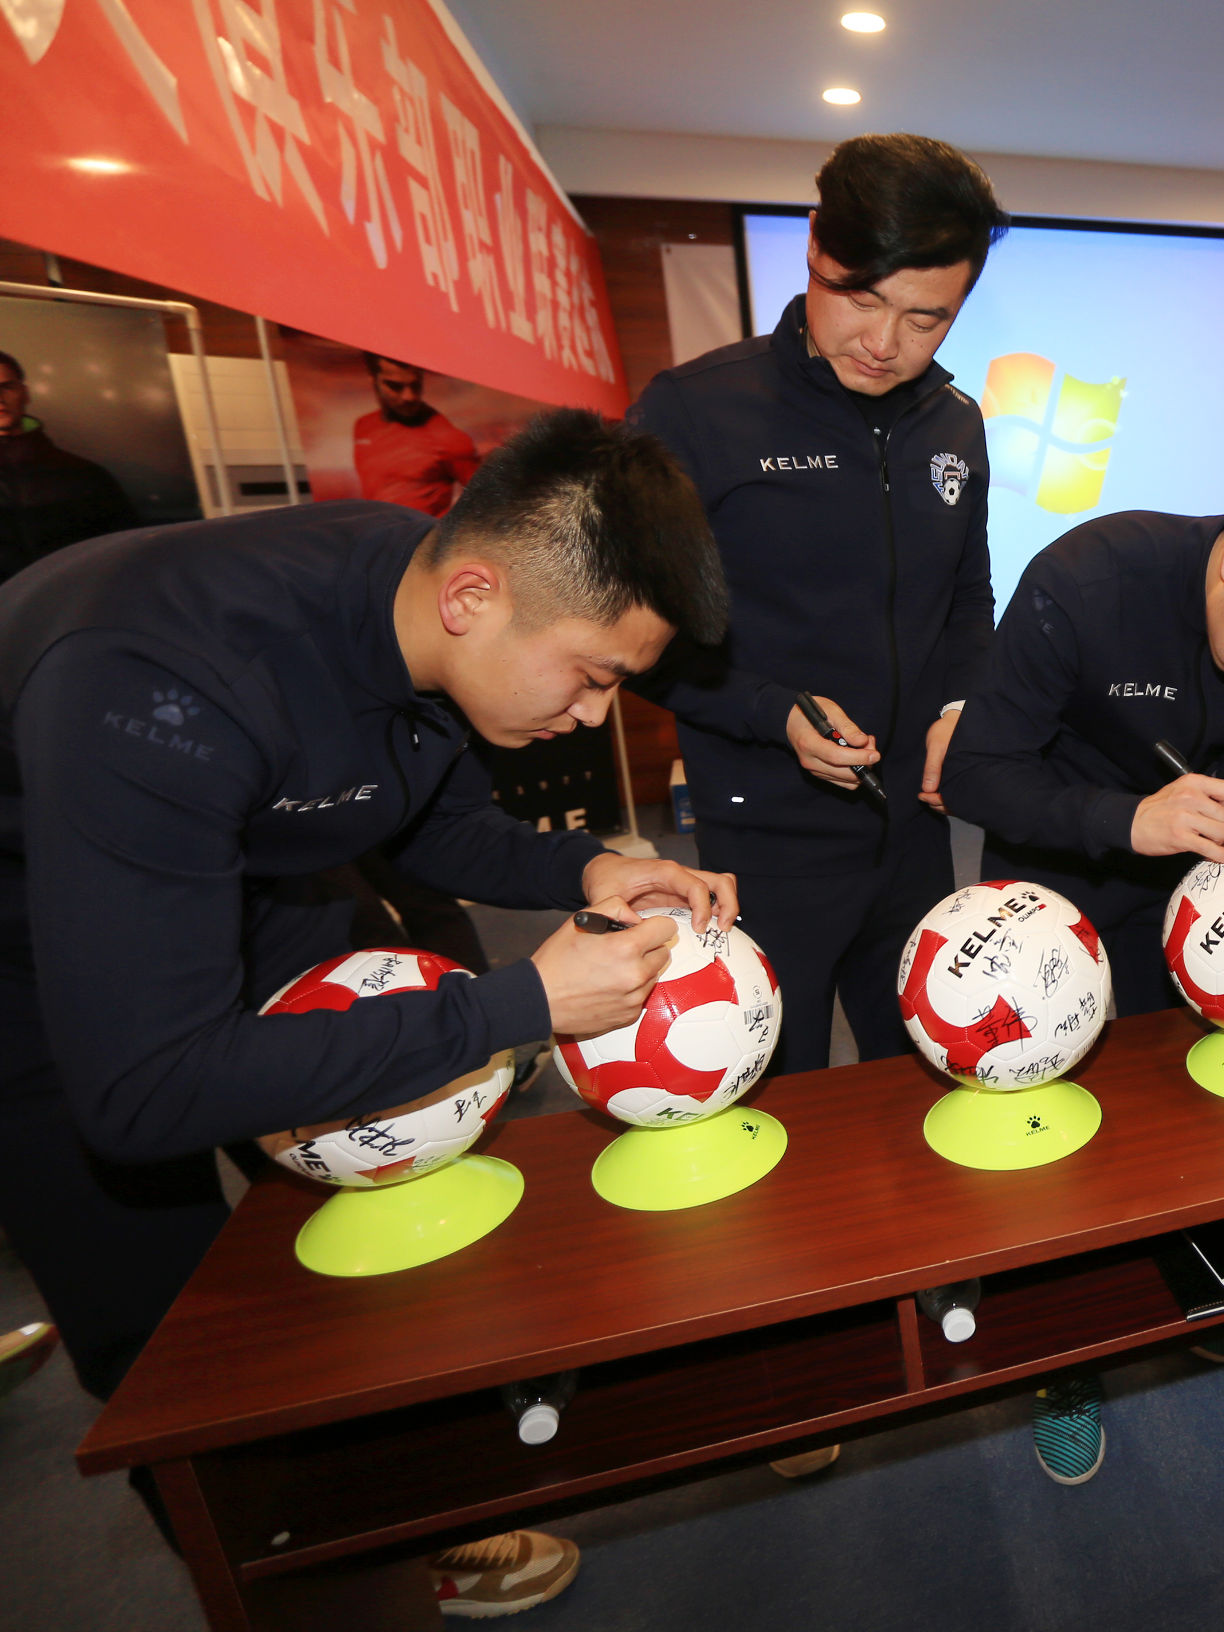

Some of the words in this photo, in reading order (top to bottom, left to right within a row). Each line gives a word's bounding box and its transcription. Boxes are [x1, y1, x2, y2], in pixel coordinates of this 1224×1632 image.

[759, 454, 839, 472] KELME
[1108, 682, 1178, 701] KELME
[103, 711, 215, 761] KELME
[272, 784, 378, 813] KELME
[947, 897, 1028, 979] KELME
